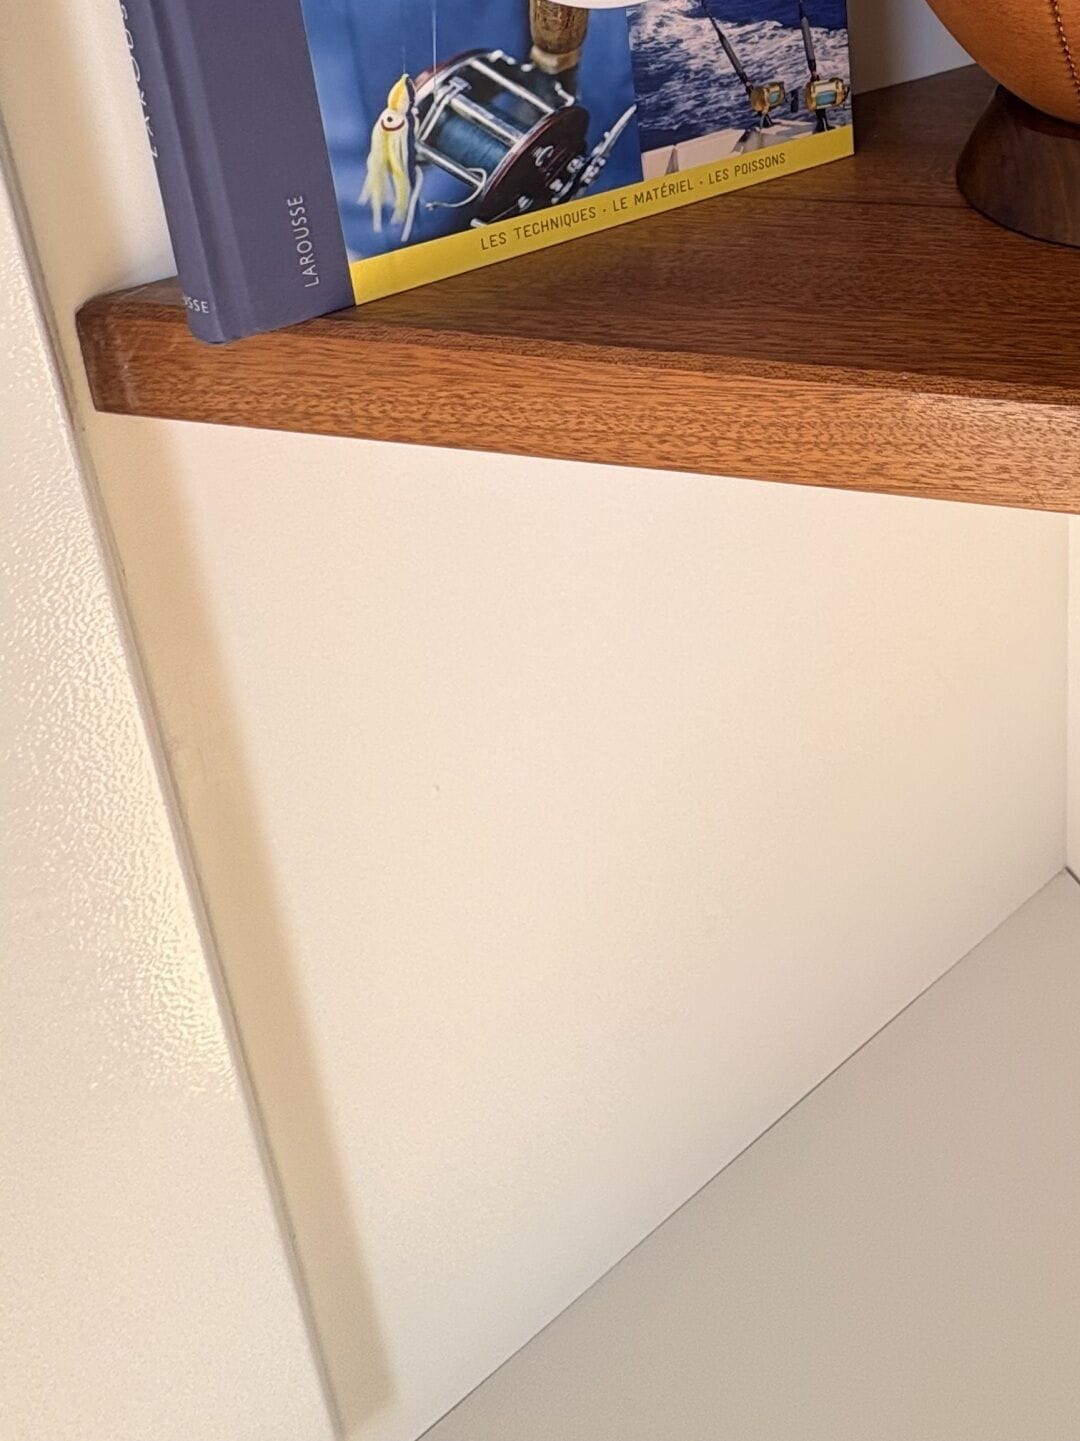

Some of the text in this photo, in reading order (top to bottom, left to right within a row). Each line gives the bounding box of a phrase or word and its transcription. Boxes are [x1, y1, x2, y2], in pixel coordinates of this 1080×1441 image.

[286, 195, 320, 288] LAROUSSE
[480, 152, 786, 250] LES TECHNIQUES LE MATÉRIEL LES POISSONS
